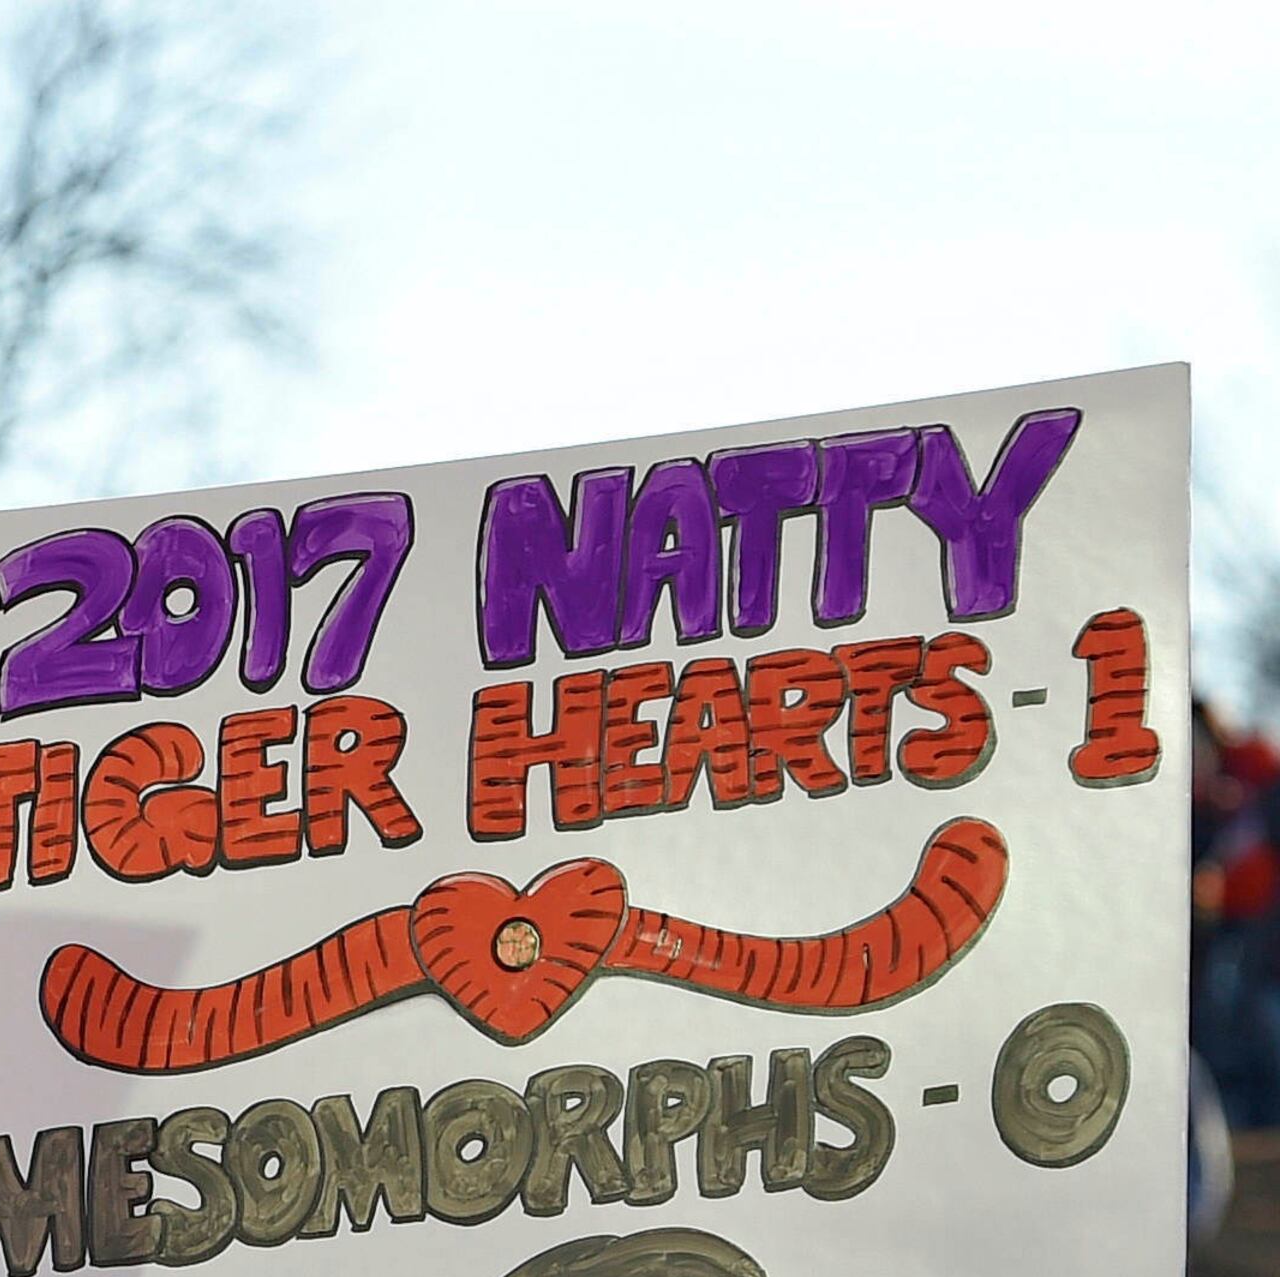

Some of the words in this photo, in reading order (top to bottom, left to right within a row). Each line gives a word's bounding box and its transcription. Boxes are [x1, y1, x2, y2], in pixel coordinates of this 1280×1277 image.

[476, 406, 1083, 670] NATTY
[466, 632, 998, 842] HEARTS
[1067, 606, 1163, 789] 1
